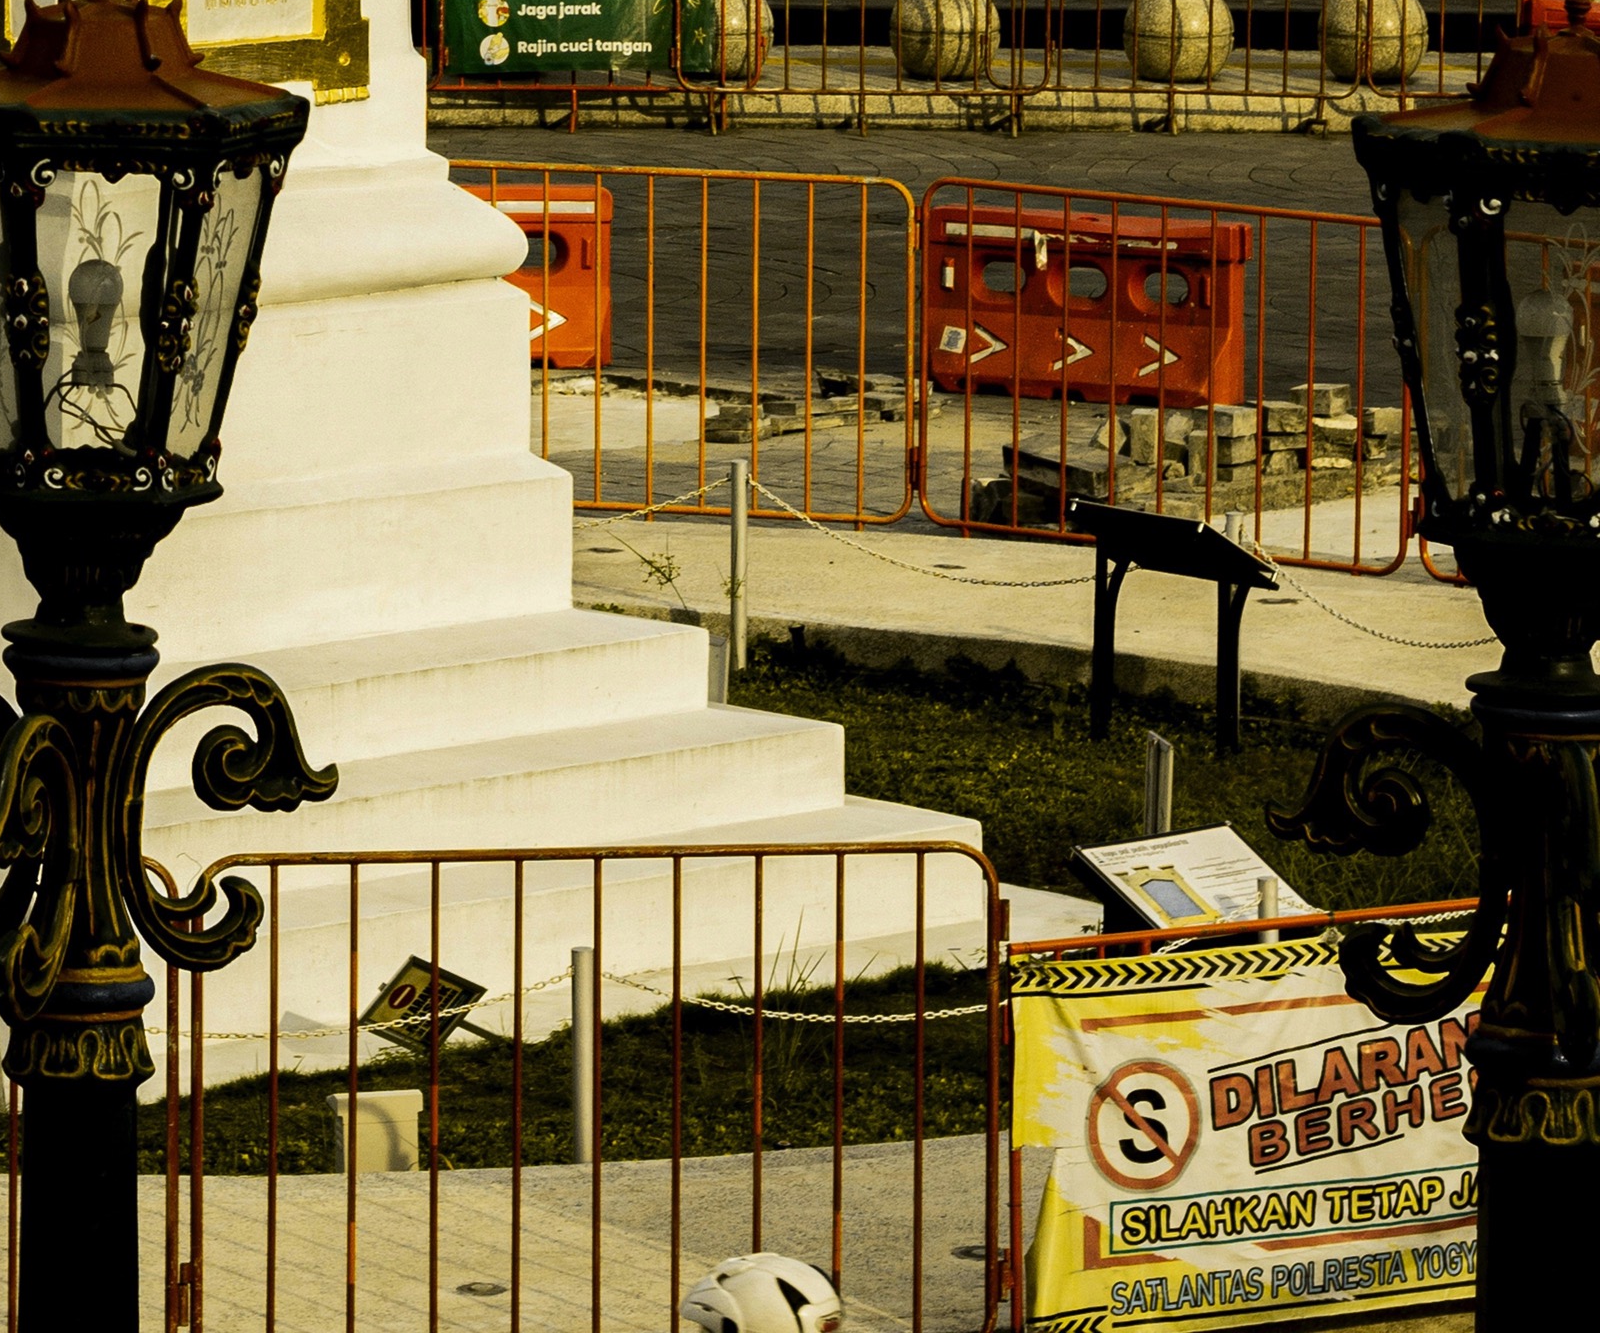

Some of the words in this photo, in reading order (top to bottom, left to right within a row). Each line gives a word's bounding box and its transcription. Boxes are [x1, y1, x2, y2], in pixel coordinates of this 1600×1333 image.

[517, 4, 557, 20] Jaga
[558, 2, 601, 20] jarak
[517, 40, 557, 57] Rajin
[560, 39, 592, 53] cuci
[595, 39, 652, 56] tangan
[1121, 1189, 1316, 1246] SILAHKAN
[1323, 1175, 1445, 1225] TETAP
[1111, 1265, 1264, 1316] SATLANTAS
[1271, 1251, 1406, 1298] POLRESTA
